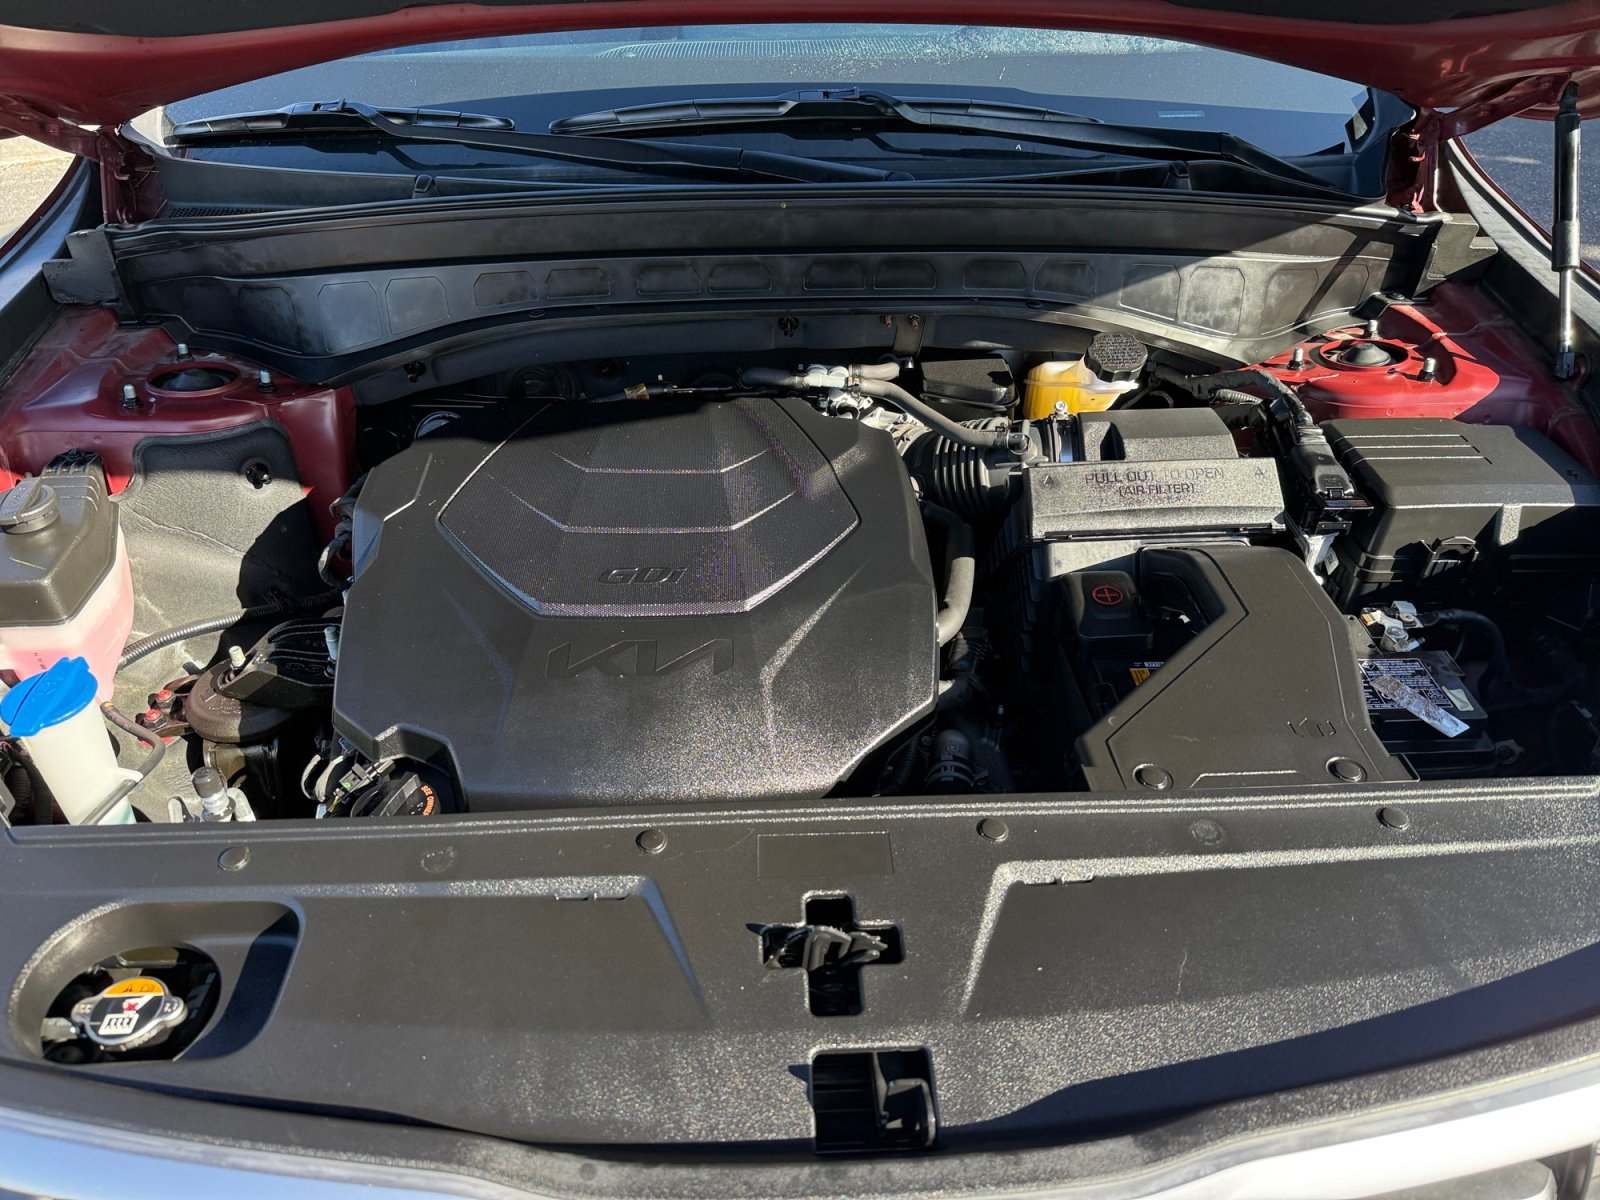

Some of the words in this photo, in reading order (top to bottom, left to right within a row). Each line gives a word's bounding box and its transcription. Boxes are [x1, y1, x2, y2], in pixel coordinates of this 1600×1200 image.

[1085, 470, 1123, 484] PULL
[1127, 469, 1155, 483] OUT
[1162, 469, 1182, 481] TO
[1187, 467, 1225, 481] OPEN
[545, 638, 734, 678] KIA
